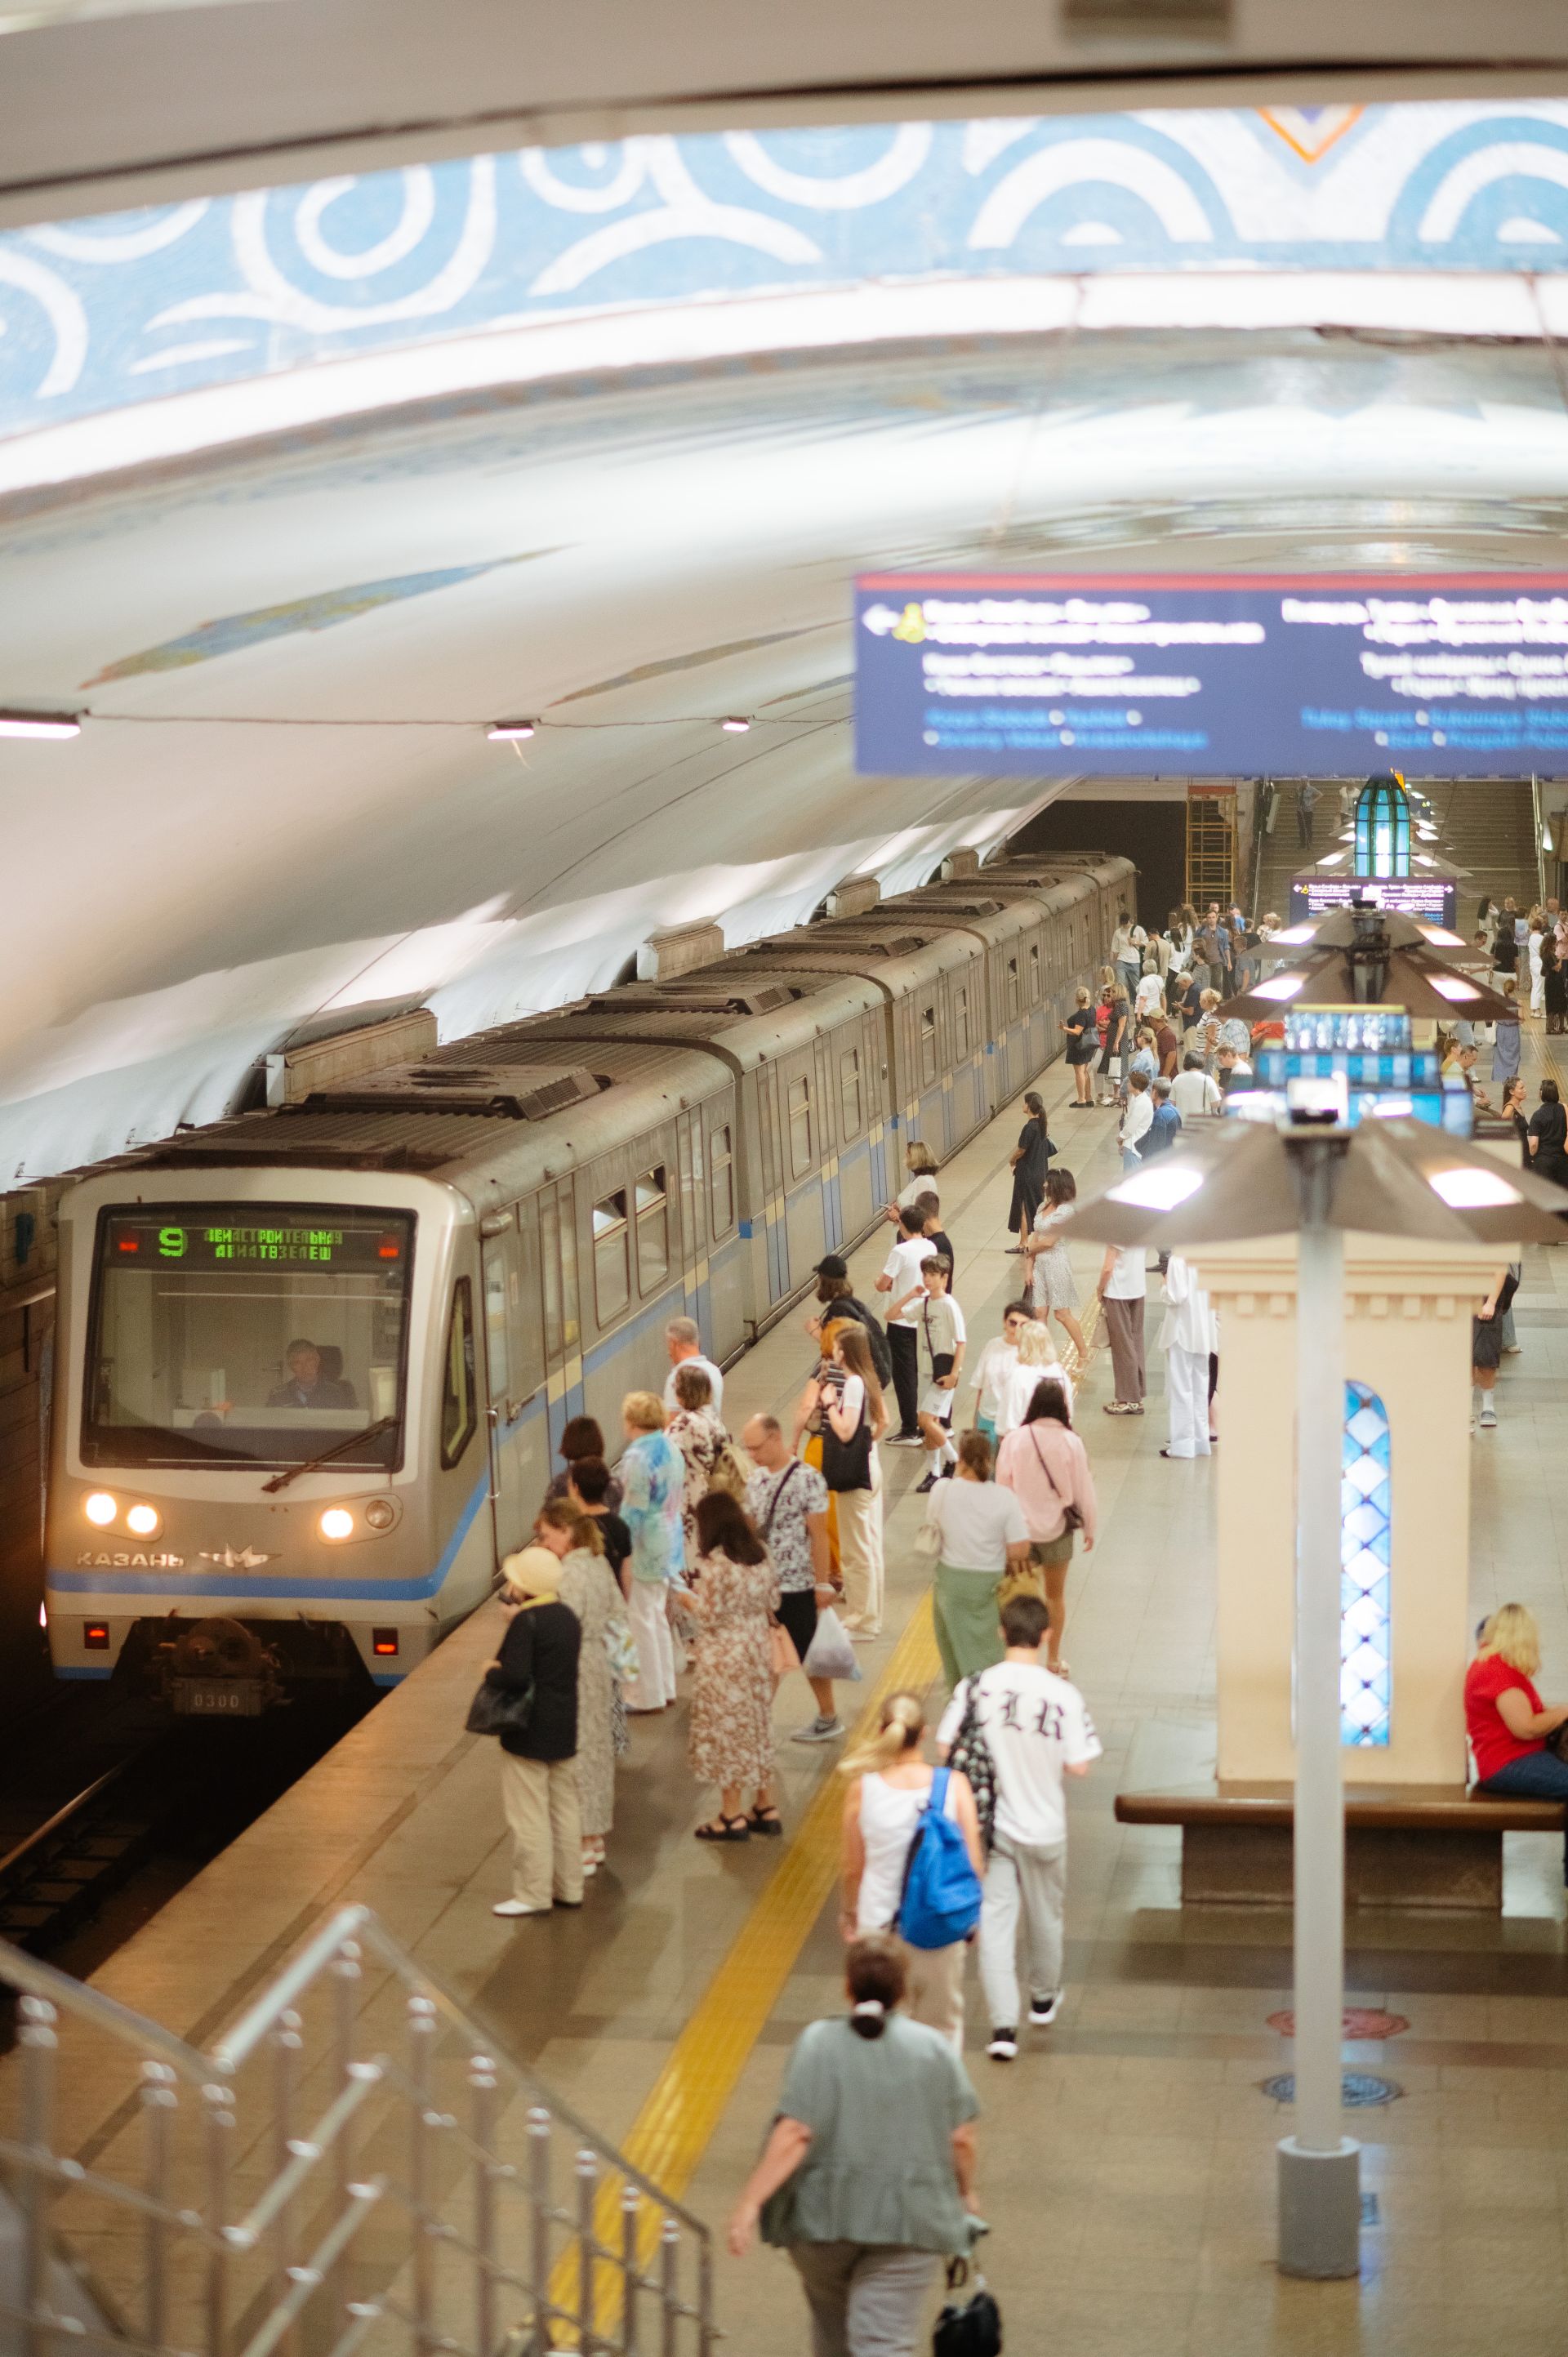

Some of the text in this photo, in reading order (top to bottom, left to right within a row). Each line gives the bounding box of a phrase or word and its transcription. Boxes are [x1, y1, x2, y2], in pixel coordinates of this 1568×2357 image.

[158, 1228, 187, 1256] 9
[77, 1552, 185, 1567] КАЗАНЬ
[194, 1694, 239, 1709] 0300
